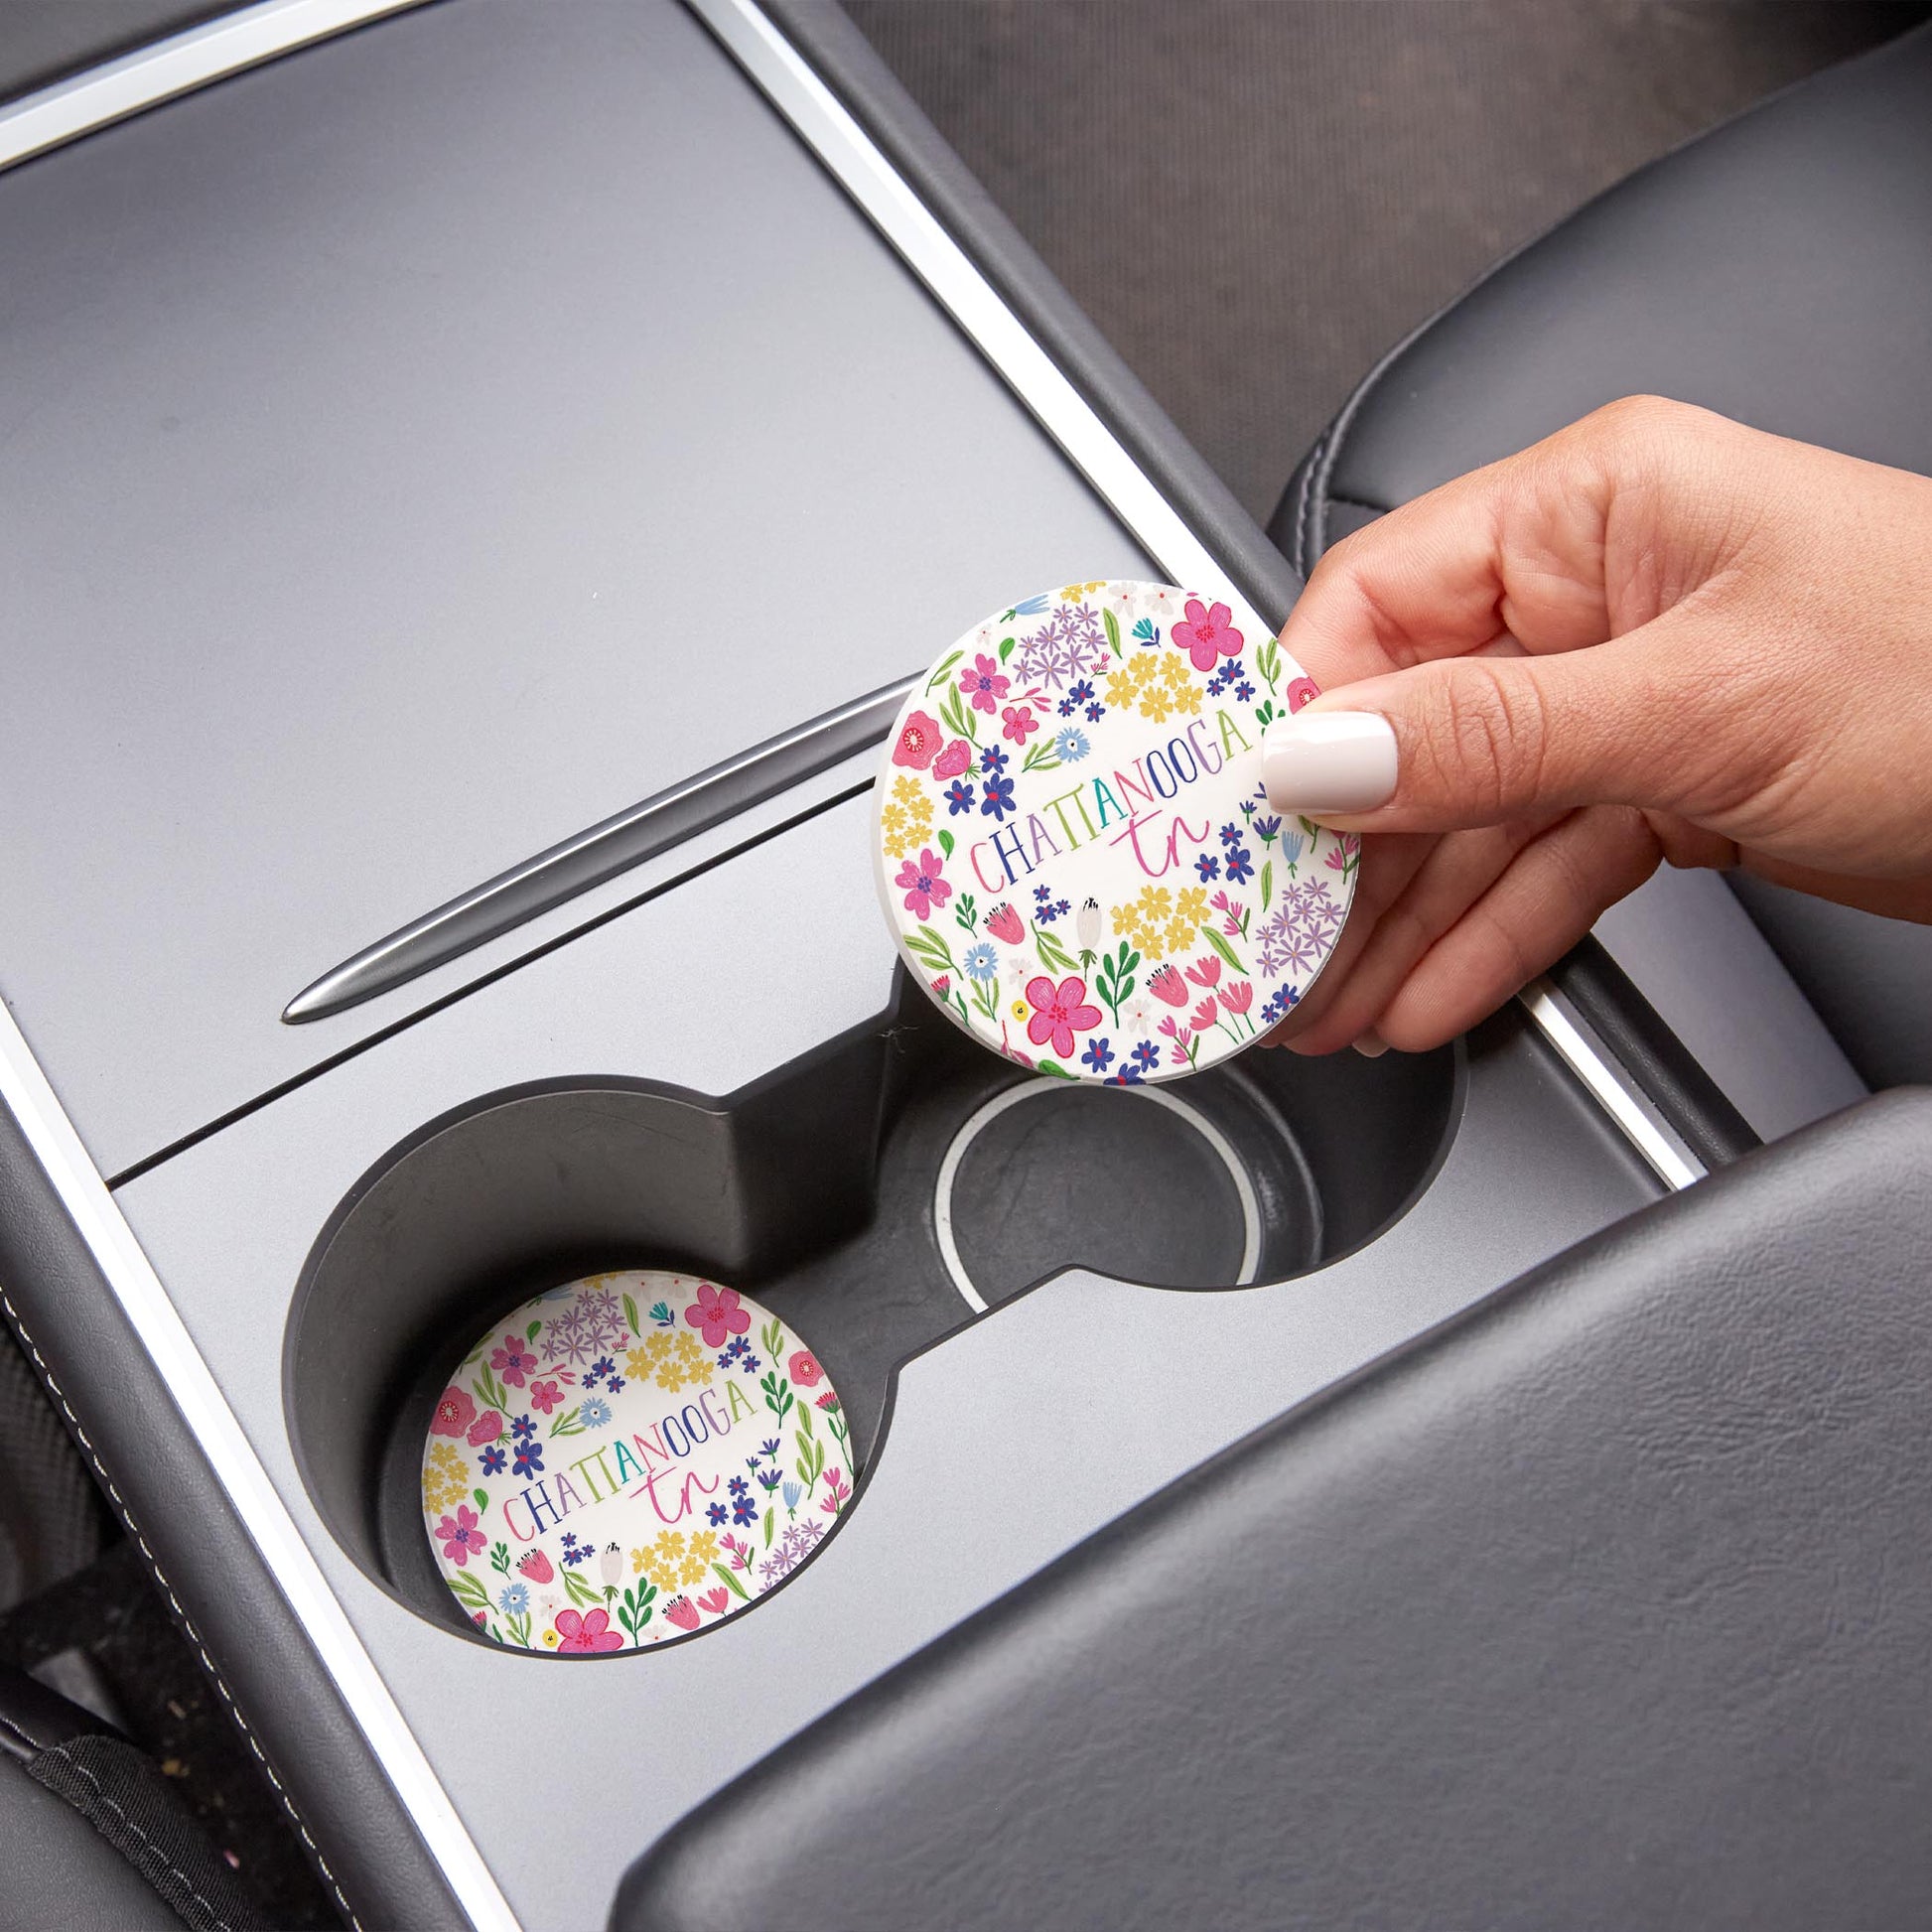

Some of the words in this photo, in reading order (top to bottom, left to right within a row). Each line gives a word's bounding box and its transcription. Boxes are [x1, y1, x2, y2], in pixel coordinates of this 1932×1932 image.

[970, 709, 1254, 894] CHATTANOOGA
[1109, 809, 1210, 878] tn
[502, 1379, 759, 1542] CHATTANOOGA
[628, 1465, 720, 1524] tn
